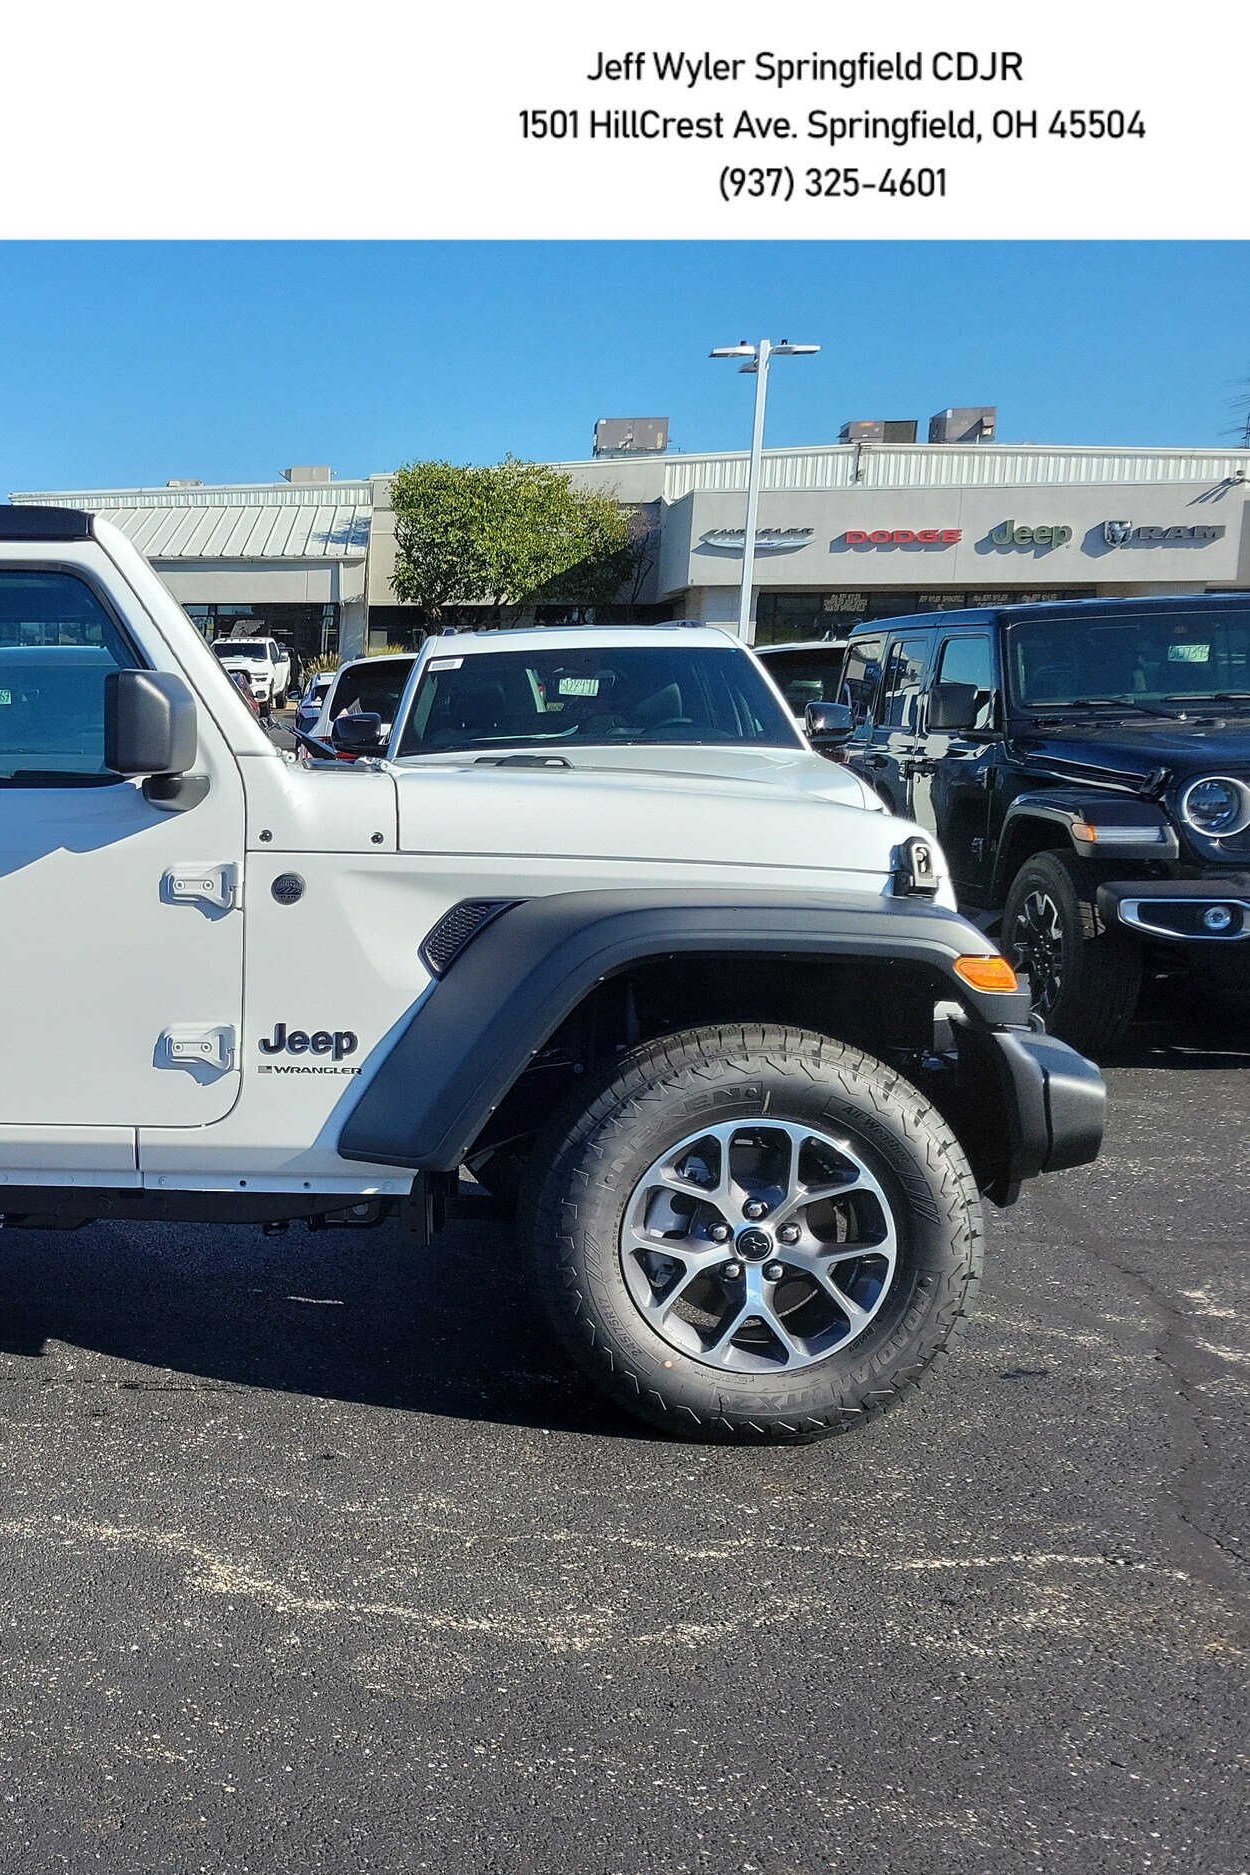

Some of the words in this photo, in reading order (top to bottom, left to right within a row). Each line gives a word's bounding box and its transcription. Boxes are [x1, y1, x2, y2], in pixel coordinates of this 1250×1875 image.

[845, 528, 963, 544] DODGE
[992, 519, 1073, 550] Jeep
[1137, 525, 1227, 540] RAM
[258, 1022, 358, 1061] Jeep
[273, 1065, 363, 1075] WRANGLER
[598, 1296, 643, 1357] 245/75R17
